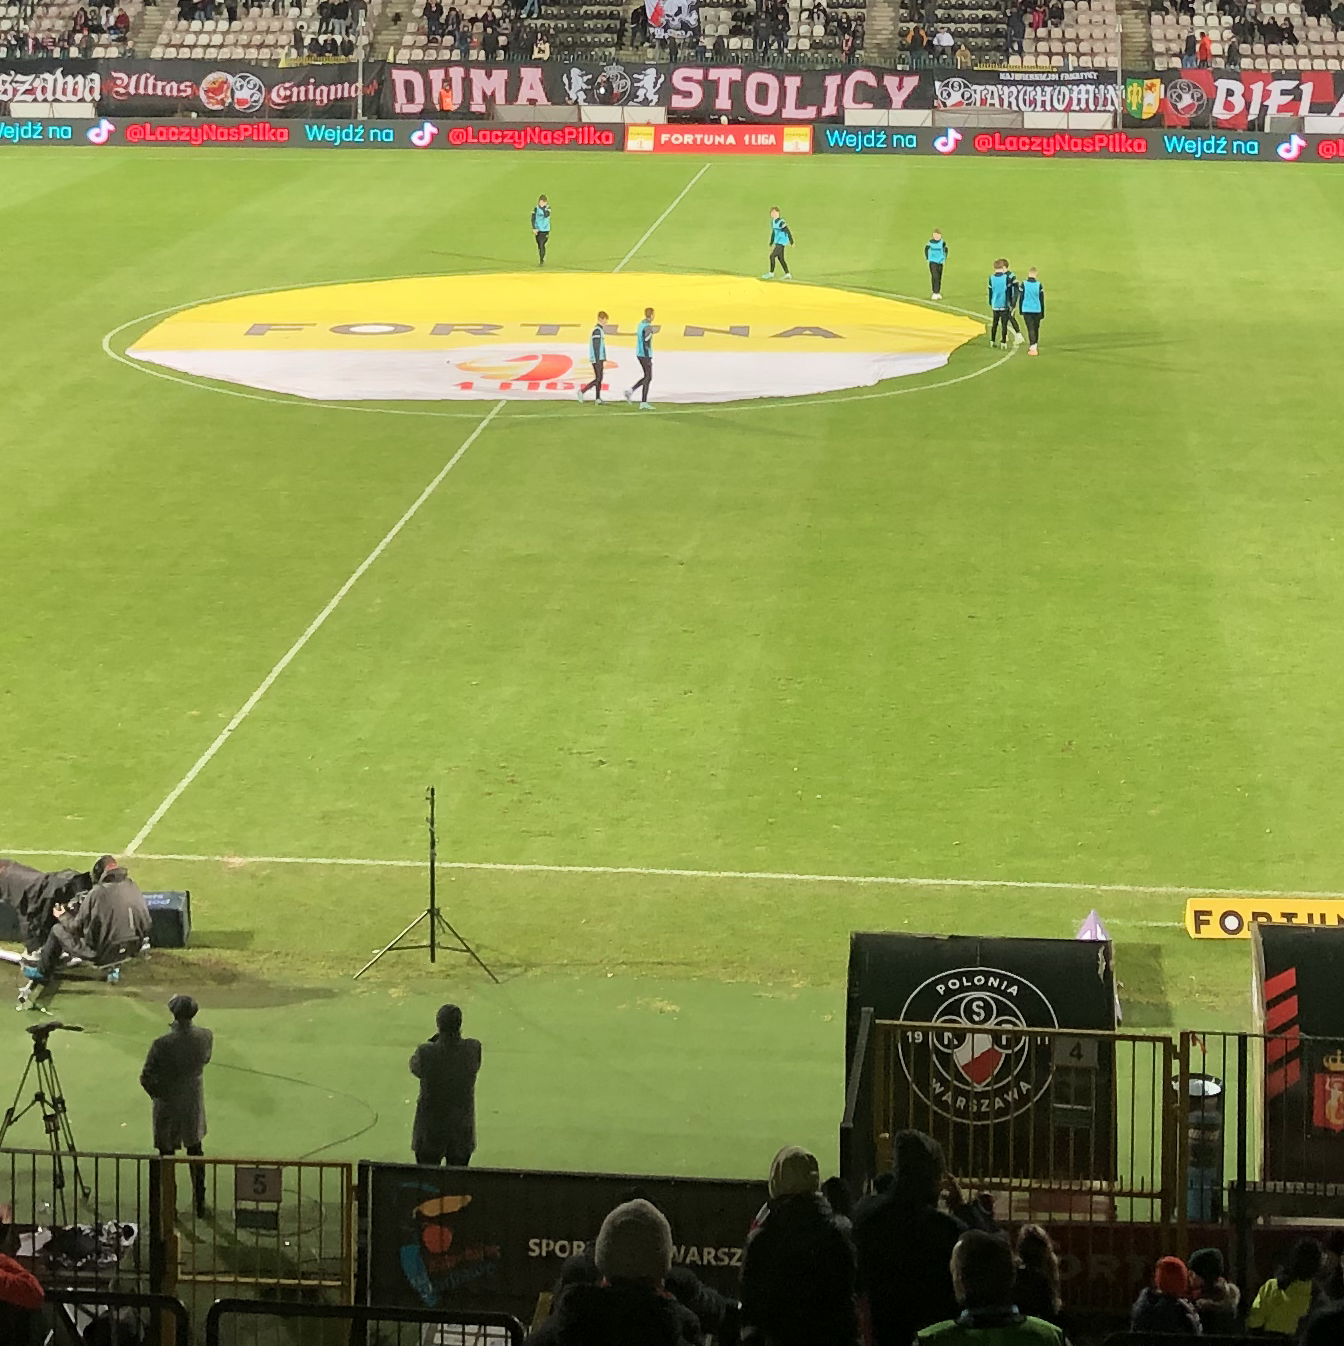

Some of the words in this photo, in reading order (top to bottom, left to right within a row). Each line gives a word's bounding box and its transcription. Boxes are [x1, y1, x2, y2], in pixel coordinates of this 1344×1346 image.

[391, 66, 552, 114] DUMA
[670, 66, 920, 120] STOLICY
[48, 125, 72, 138] na
[305, 123, 364, 145] Wejdź
[370, 128, 394, 141] na
[661, 133, 737, 146] FORTUNA
[743, 134, 750, 146] 1
[751, 134, 777, 146] LIGA
[826, 129, 887, 152] Wejdź
[893, 134, 916, 147] na
[1163, 135, 1227, 158] Wejdź
[1233, 140, 1258, 154] na
[244, 322, 846, 339] FORTUNA
[936, 975, 1019, 996] POLONIA
[1069, 1041, 1083, 1061] 4
[253, 1173, 268, 1195] 5
